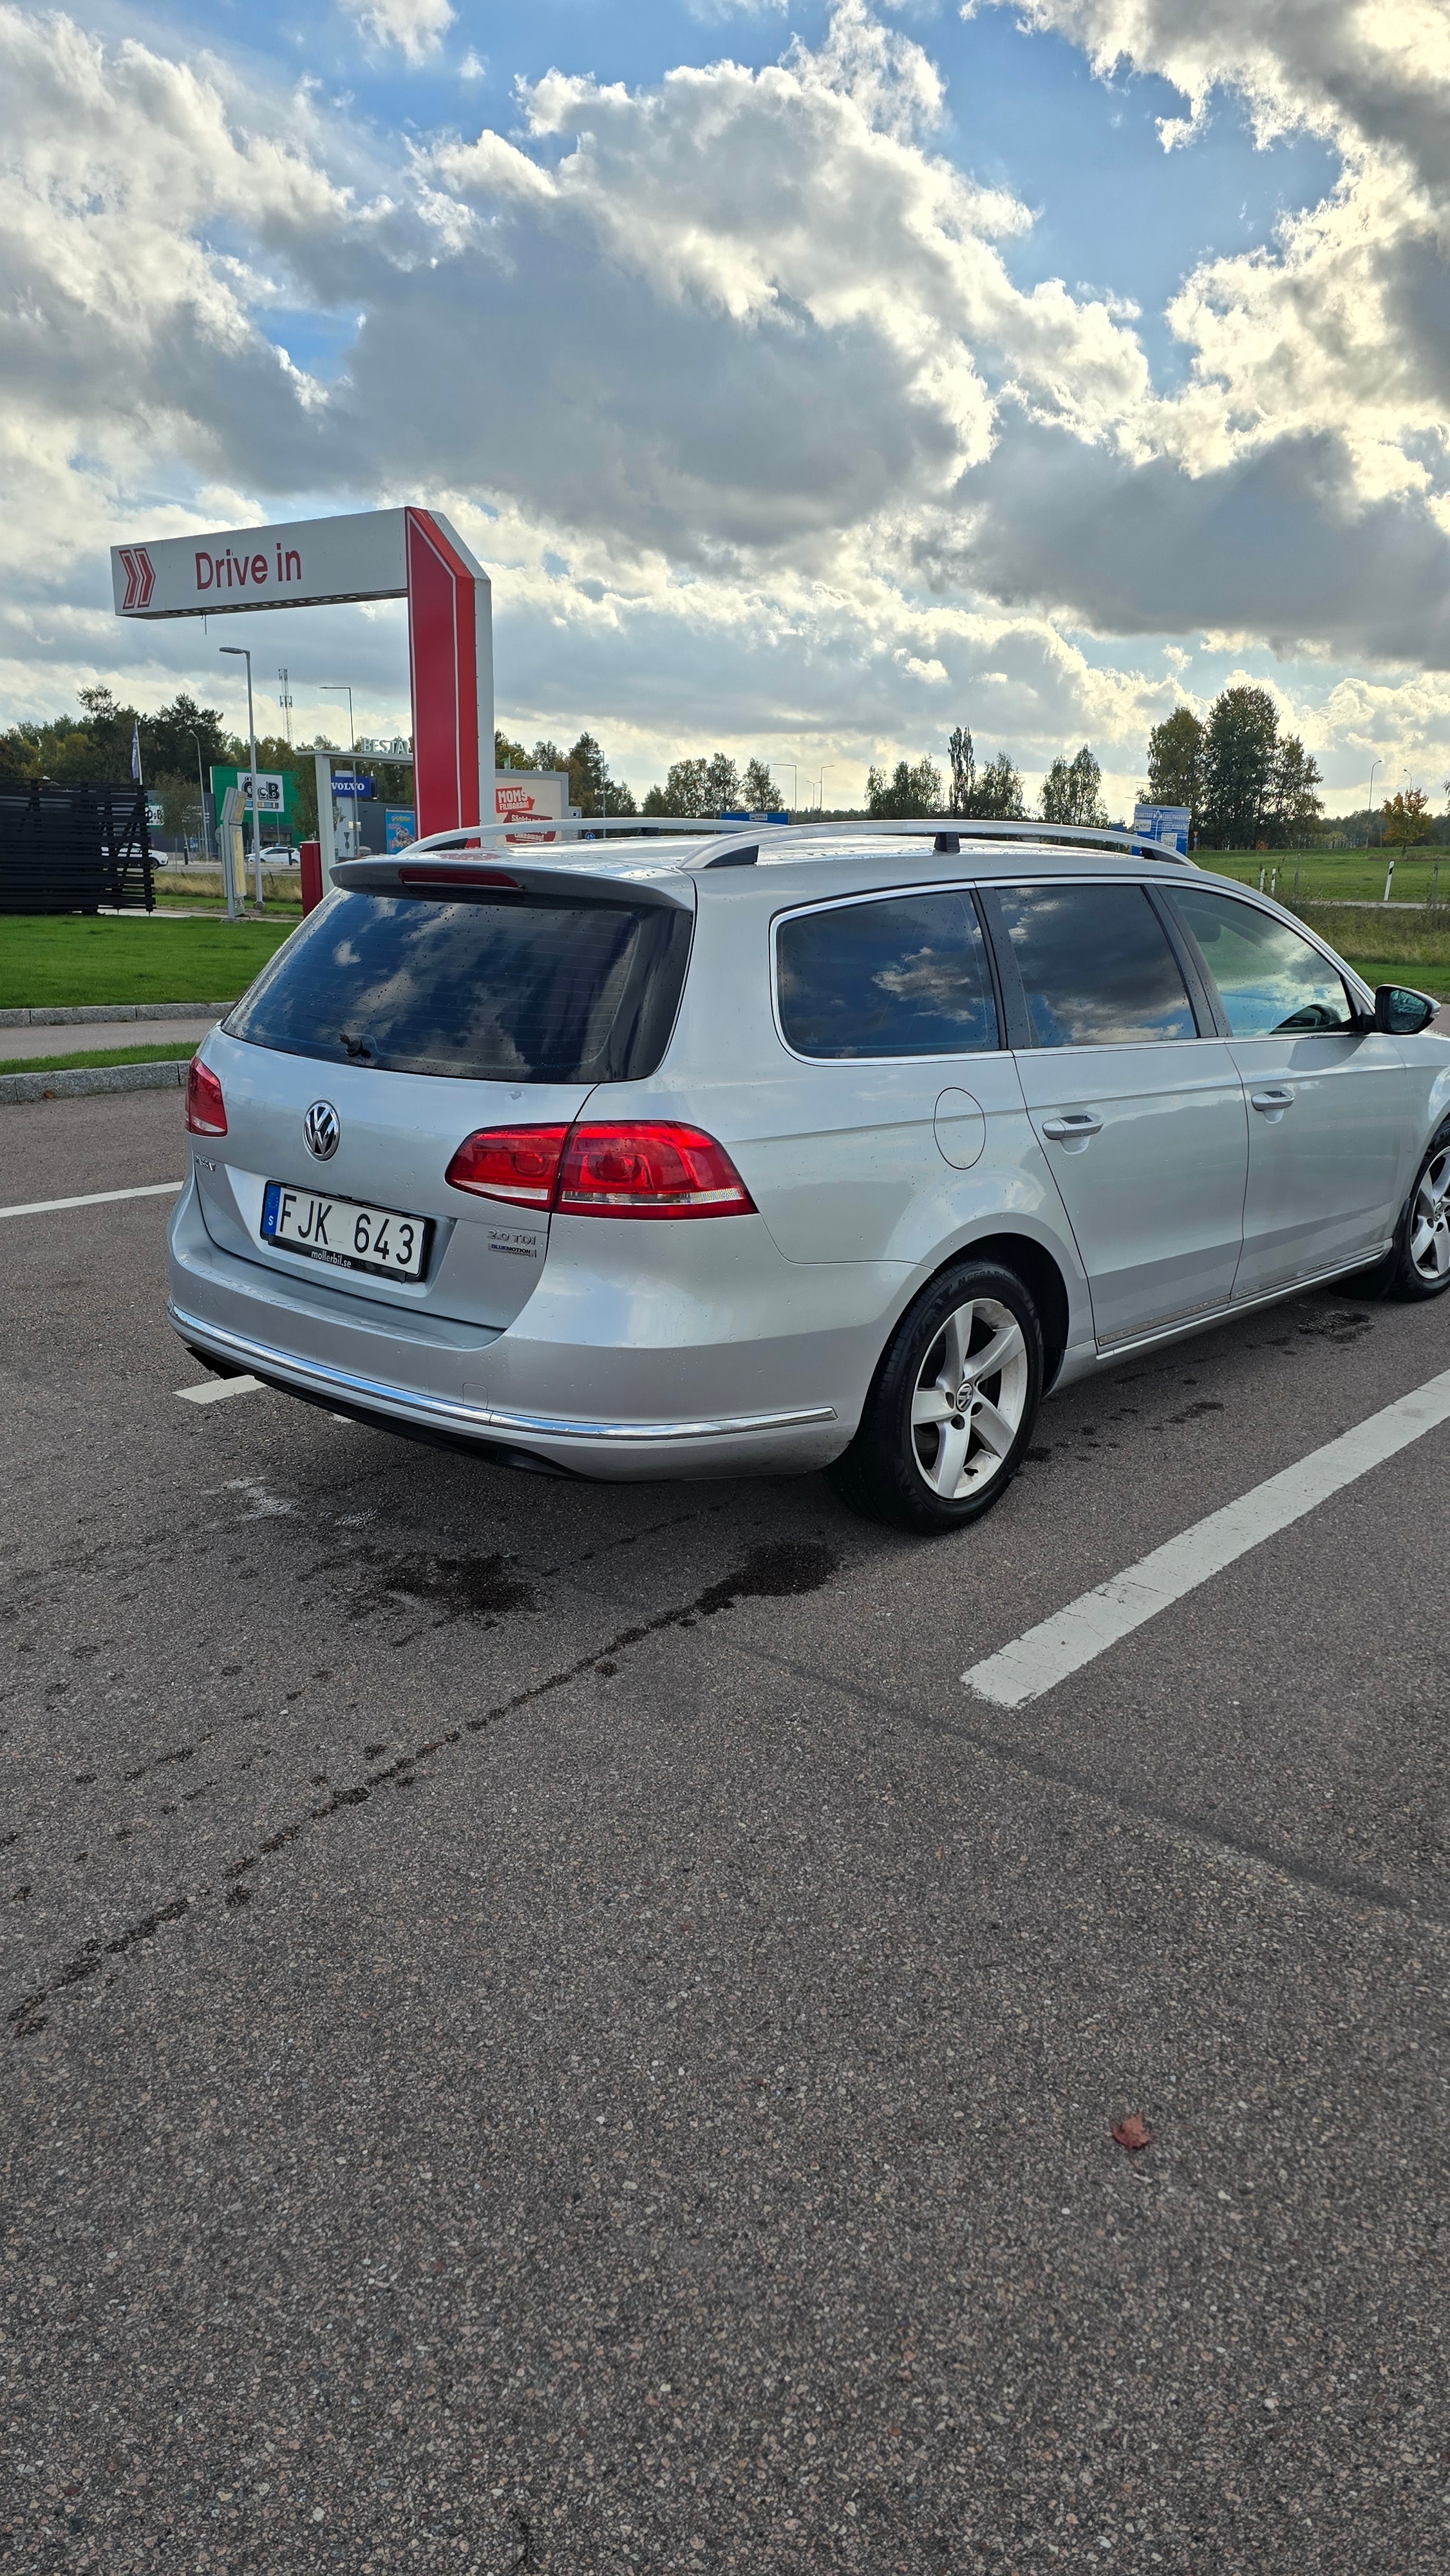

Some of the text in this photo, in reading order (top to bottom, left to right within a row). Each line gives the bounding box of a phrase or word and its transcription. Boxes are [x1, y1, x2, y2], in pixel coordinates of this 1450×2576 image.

[195, 543, 301, 590] Drive in
[331, 782, 365, 791] VOLVO
[498, 790, 528, 803] MOMS
[499, 801, 529, 811] FILIBABBA!
[279, 1193, 414, 1265] FJK 643
[487, 1229, 509, 1242] 2.0
[491, 1244, 531, 1254] BLUEMOTION
[311, 1250, 352, 1268] mollerbil.se
